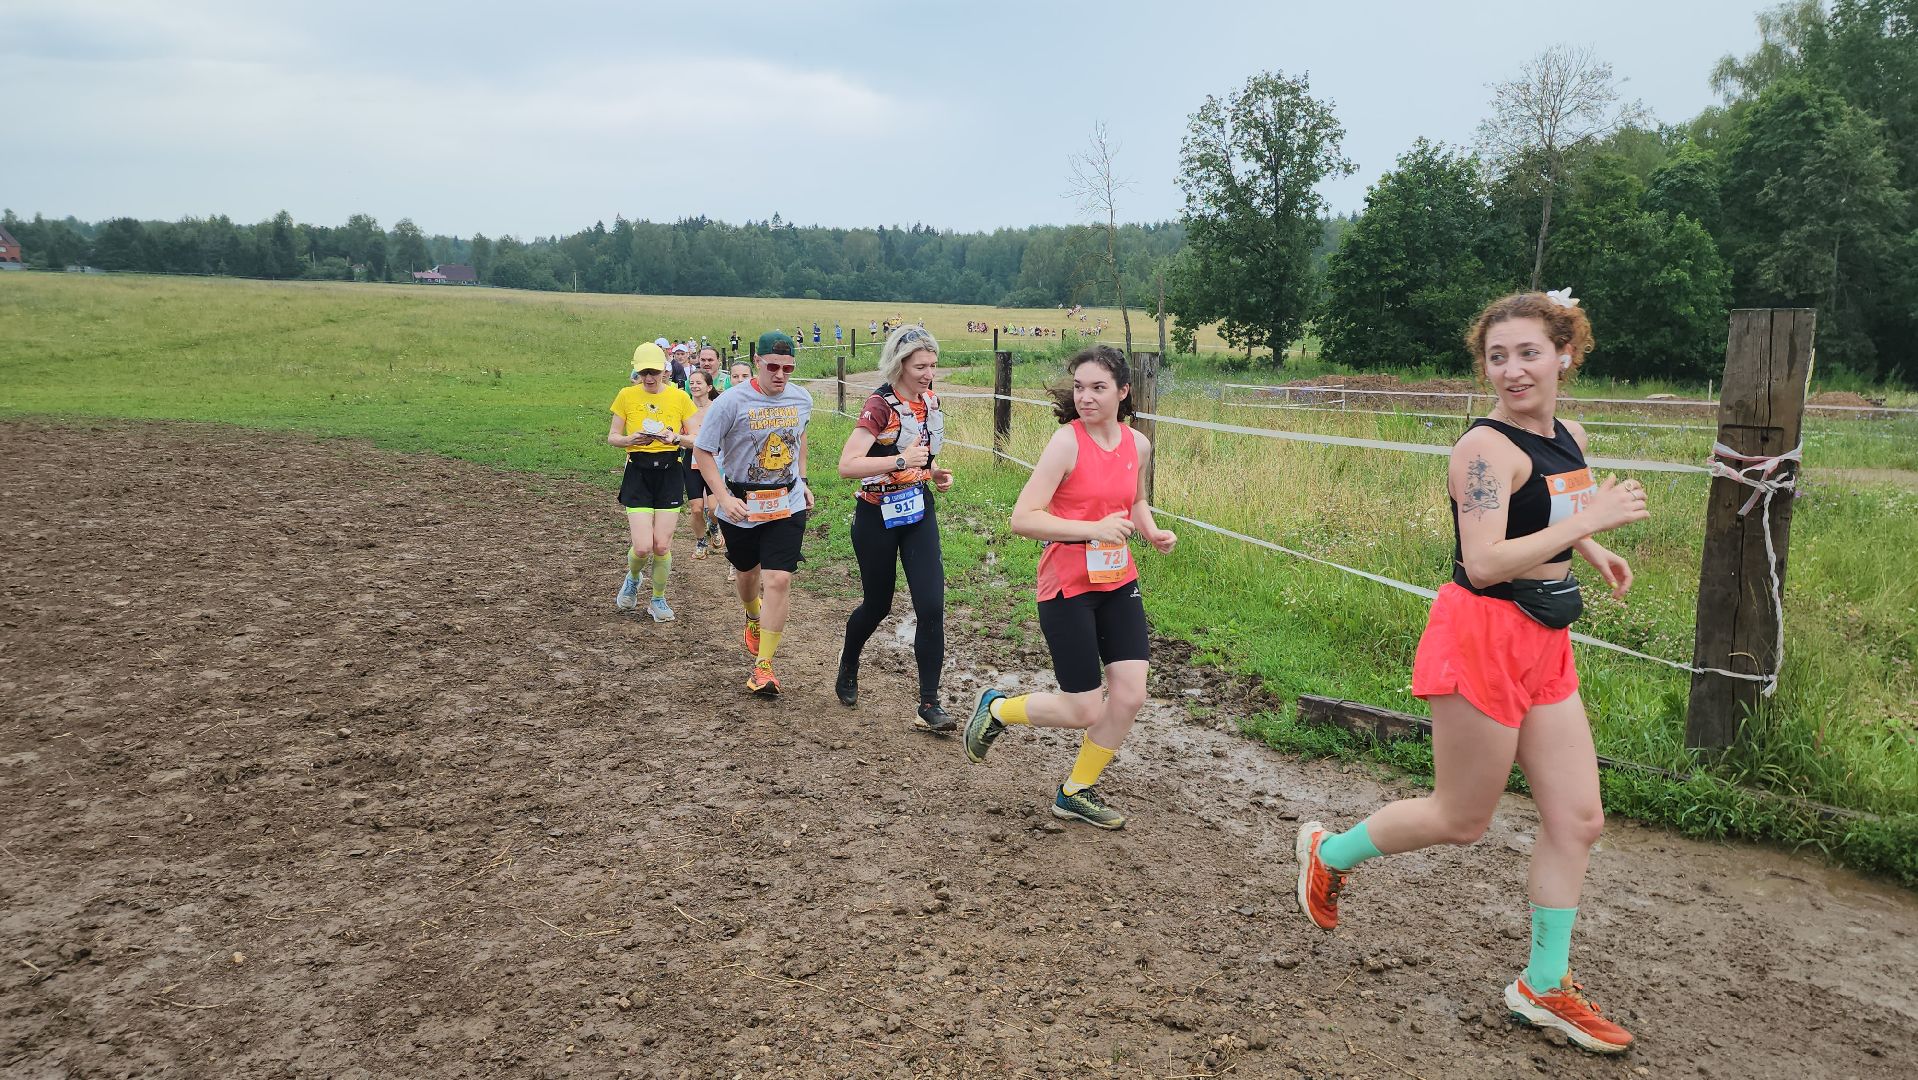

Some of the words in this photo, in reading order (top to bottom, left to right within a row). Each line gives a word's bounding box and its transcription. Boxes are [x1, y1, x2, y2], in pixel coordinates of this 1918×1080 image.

[759, 499, 779, 511] 735
[894, 499, 915, 513] 917
[1570, 490, 1592, 514] 79
